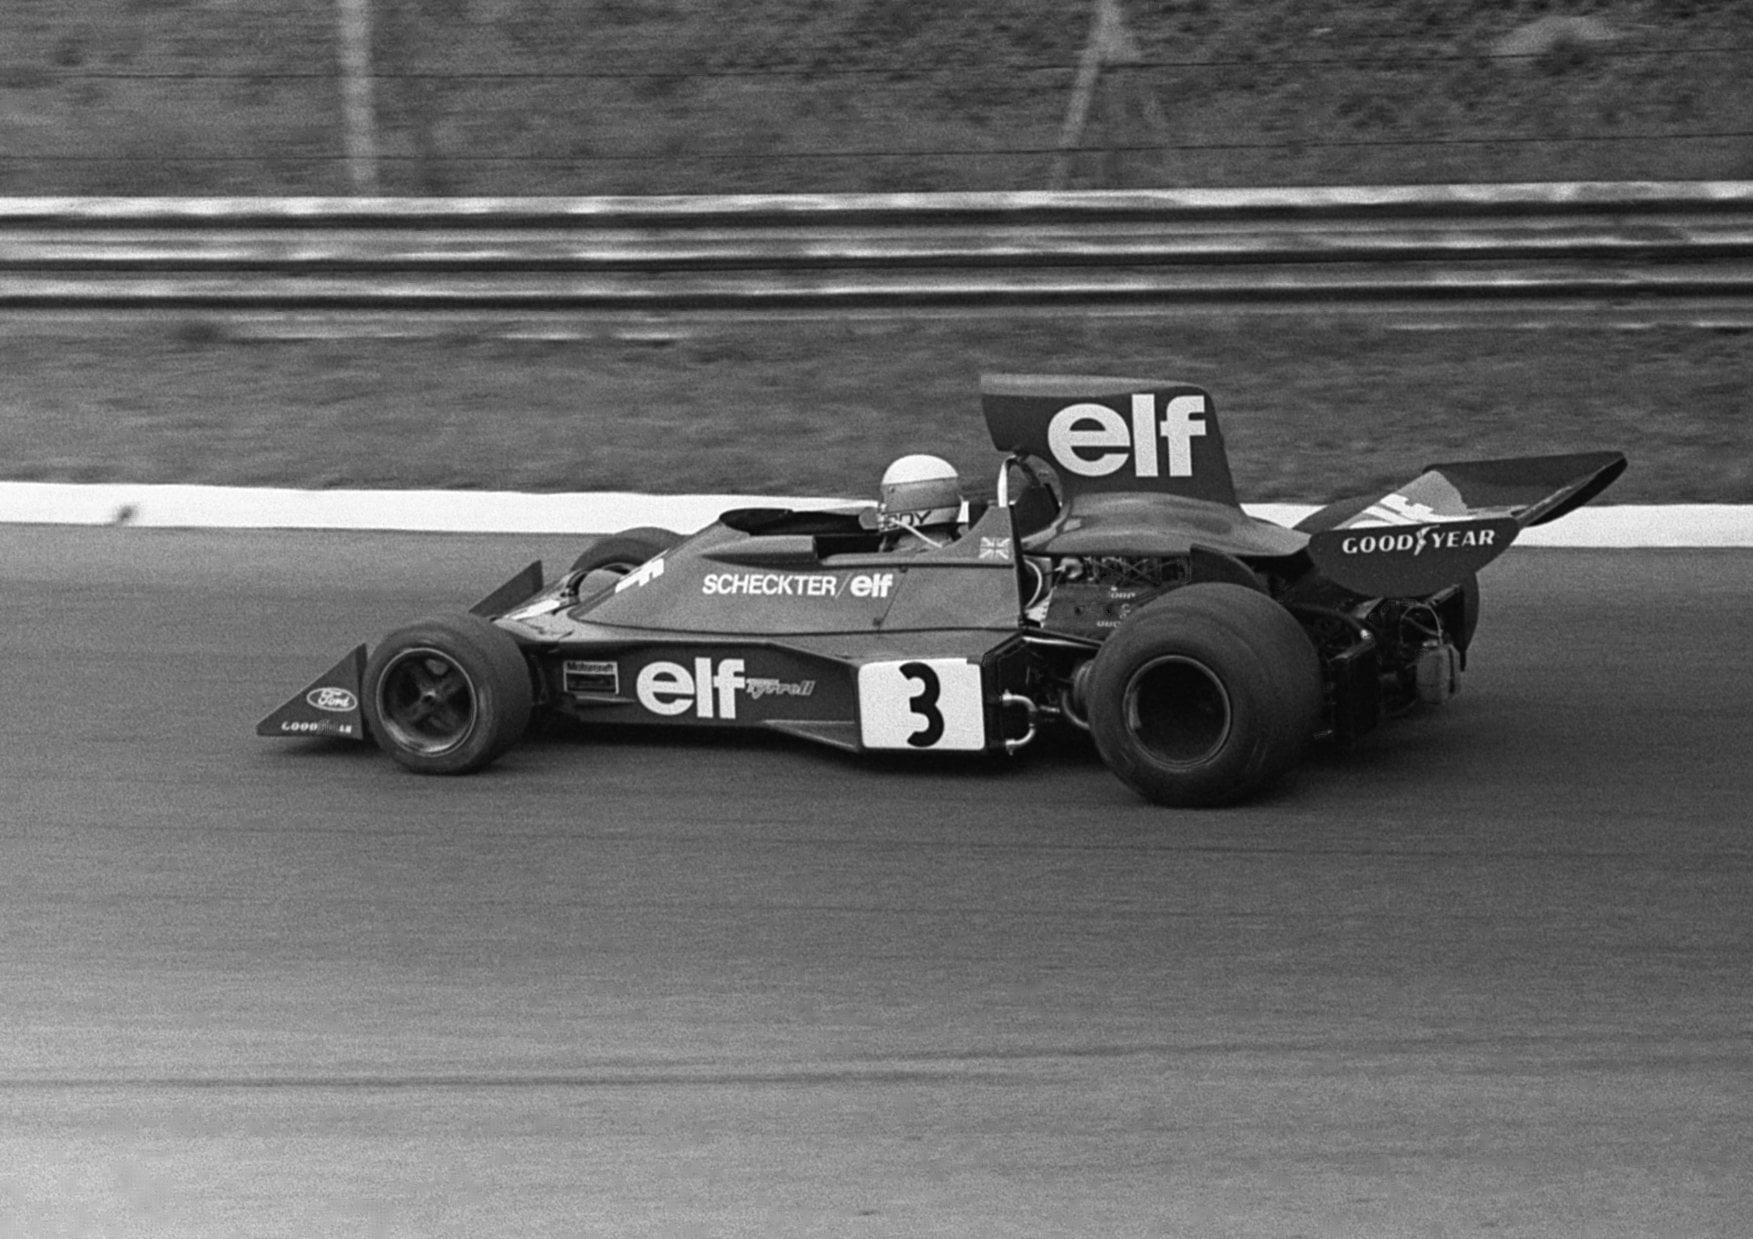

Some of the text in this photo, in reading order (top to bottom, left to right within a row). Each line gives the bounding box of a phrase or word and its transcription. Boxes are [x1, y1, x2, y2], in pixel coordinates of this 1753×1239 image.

[1048, 394, 1206, 477] elf
[850, 573, 893, 597] elf
[318, 688, 350, 707] Ford
[636, 657, 745, 719] elf
[899, 662, 945, 748] 3
